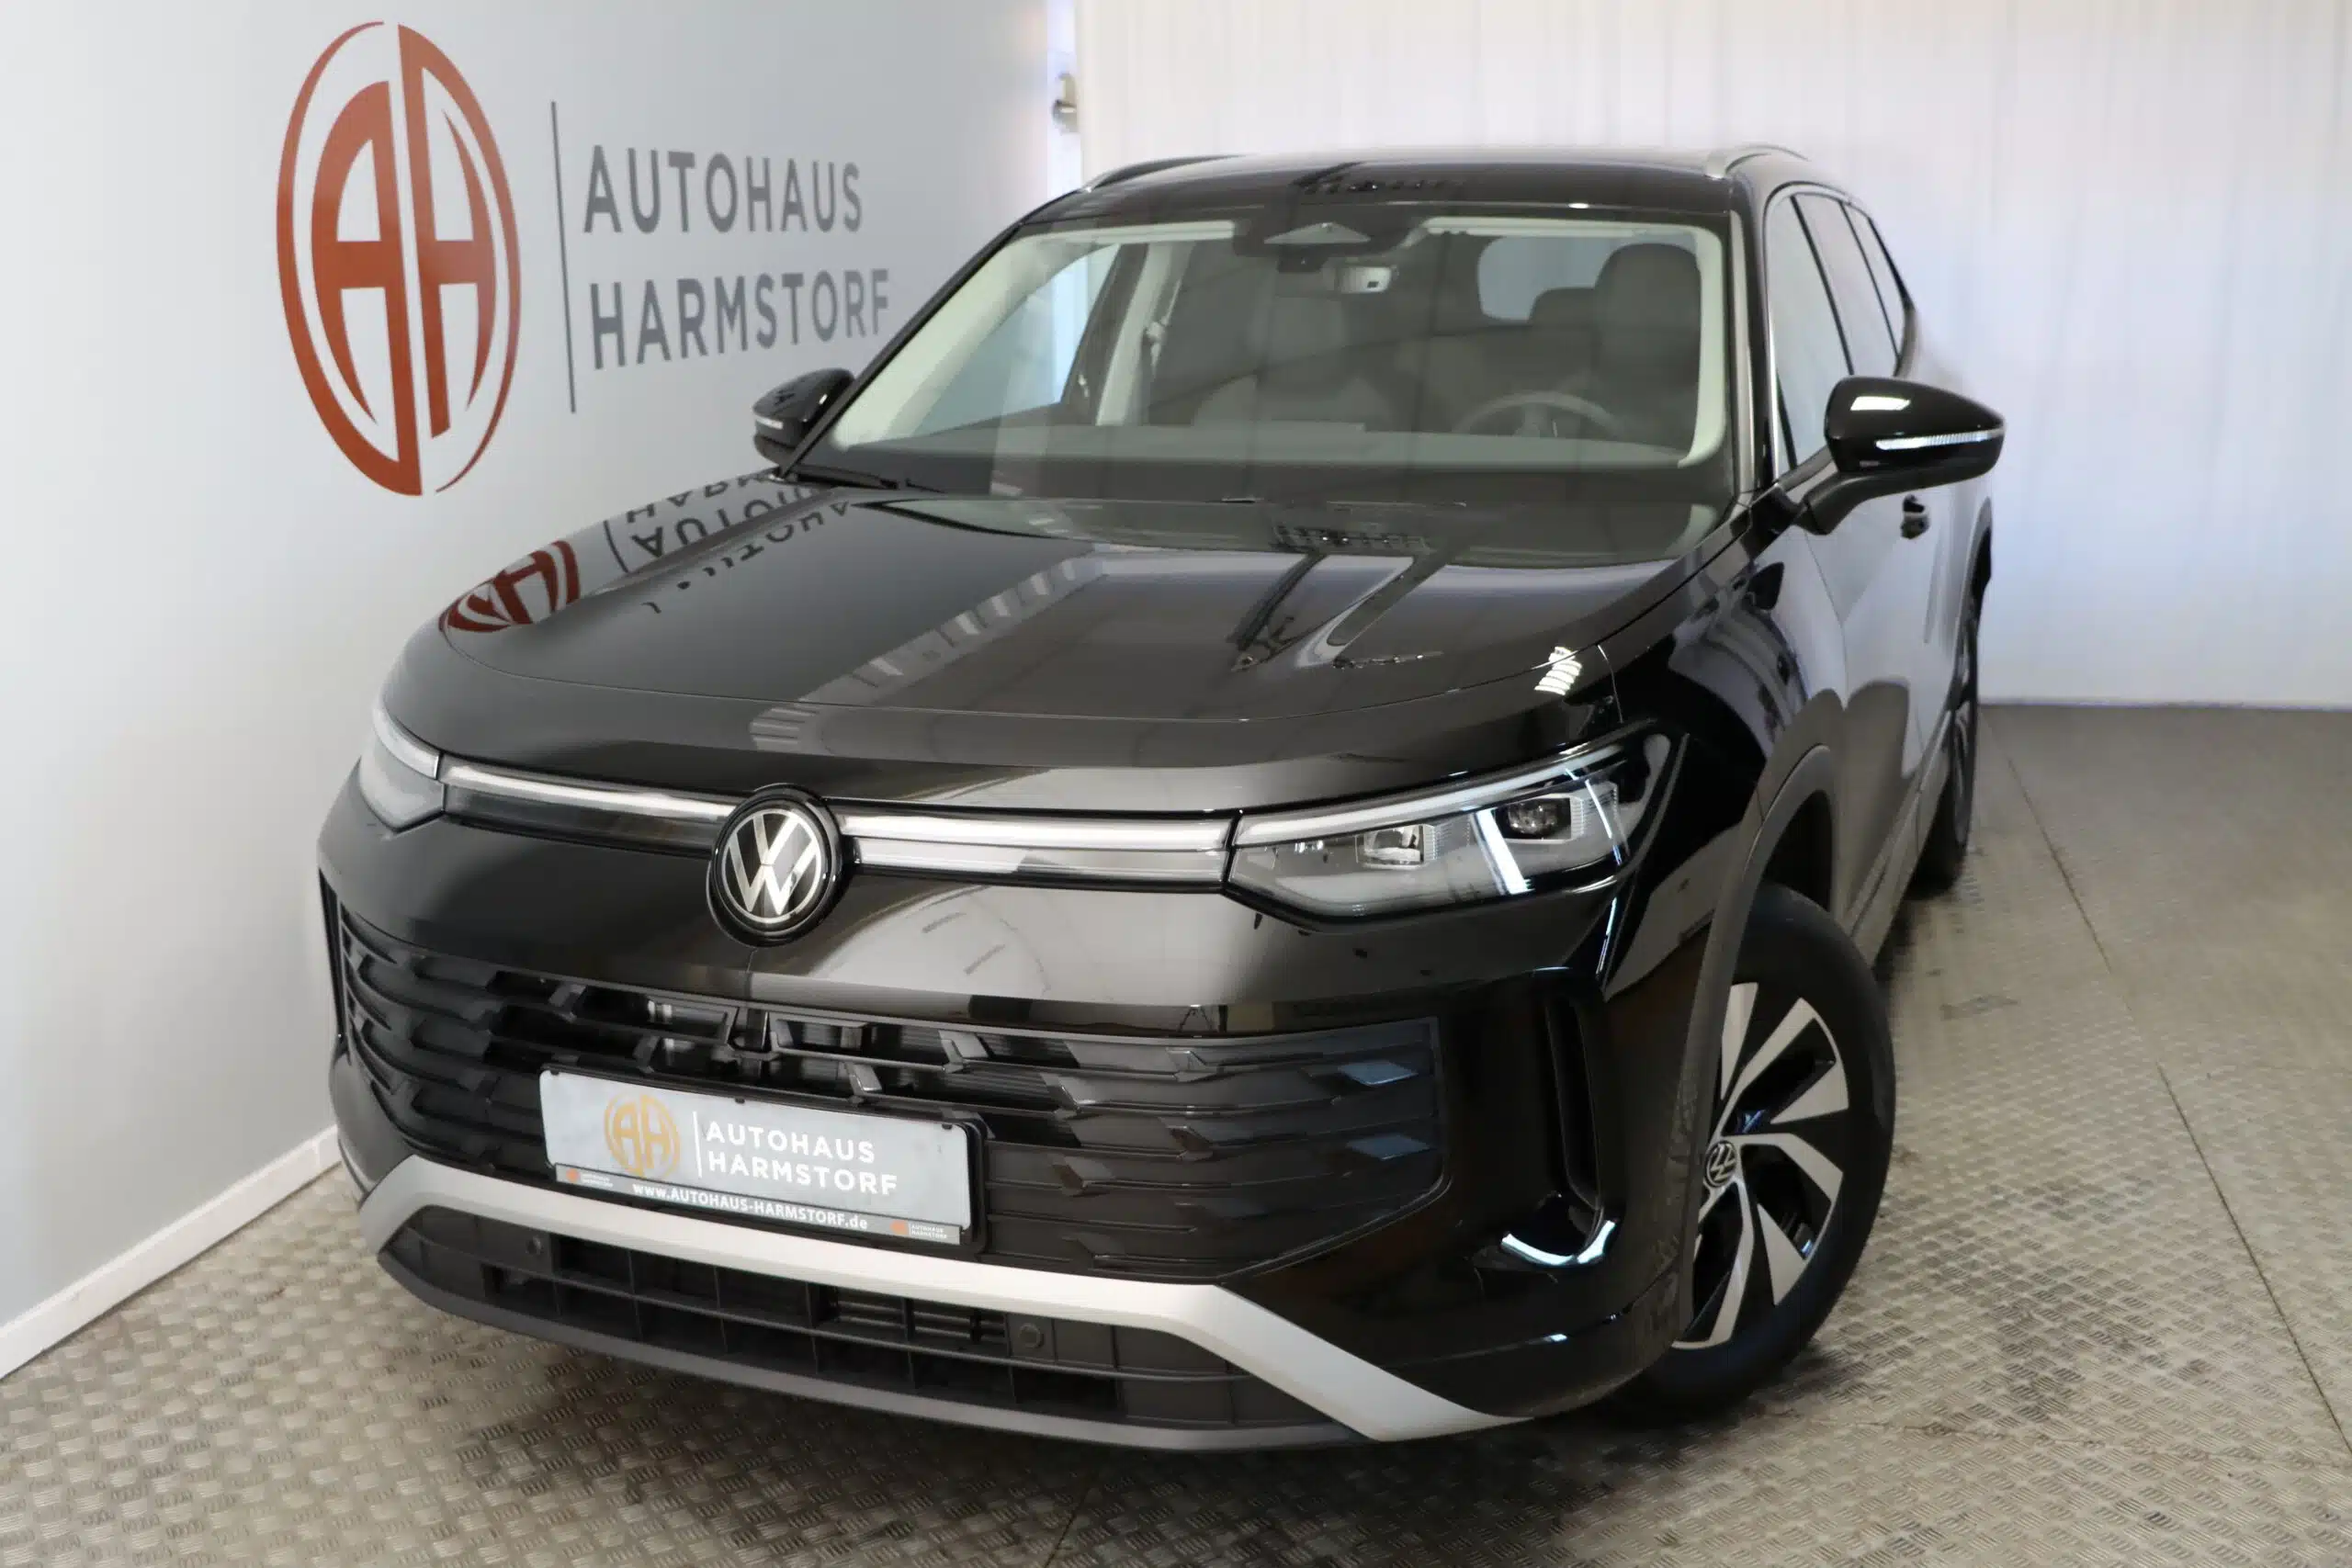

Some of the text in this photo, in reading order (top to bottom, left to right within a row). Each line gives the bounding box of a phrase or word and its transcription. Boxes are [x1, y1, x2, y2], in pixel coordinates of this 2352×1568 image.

[583, 144, 864, 233] AUTOHAUS
[589, 268, 890, 370] HARMSTORF
[706, 1120, 876, 1164] AUTOHAUS
[708, 1150, 898, 1196] HARMSTORF
[632, 1183, 868, 1230] www.AUTOHAUS-HARMSTORF.de
